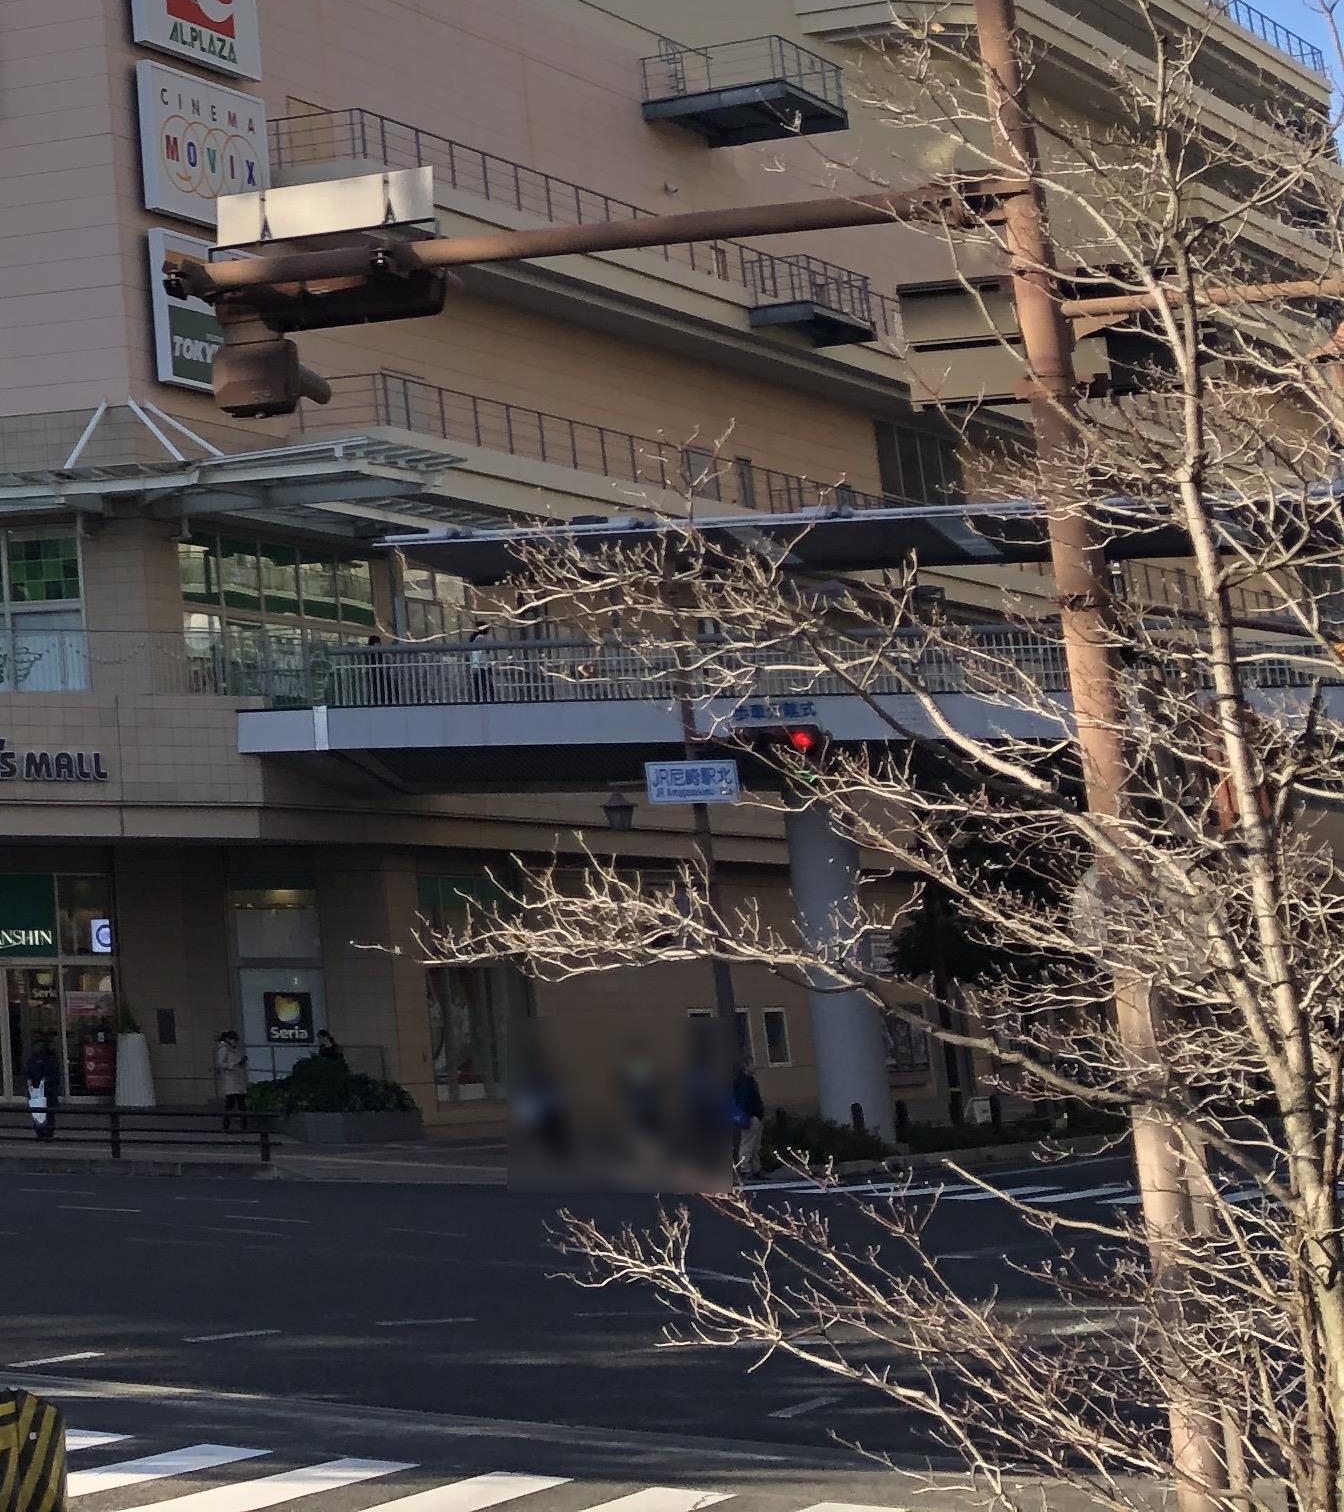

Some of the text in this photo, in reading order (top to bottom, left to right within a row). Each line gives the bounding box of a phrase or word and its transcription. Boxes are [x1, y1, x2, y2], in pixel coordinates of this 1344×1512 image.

[160, 88, 256, 134] CINEMA
[165, 134, 257, 187] MOVIX
[173, 335, 220, 364] TOKY
[24, 751, 108, 780] MALL
[270, 1026, 308, 1040] Seria
